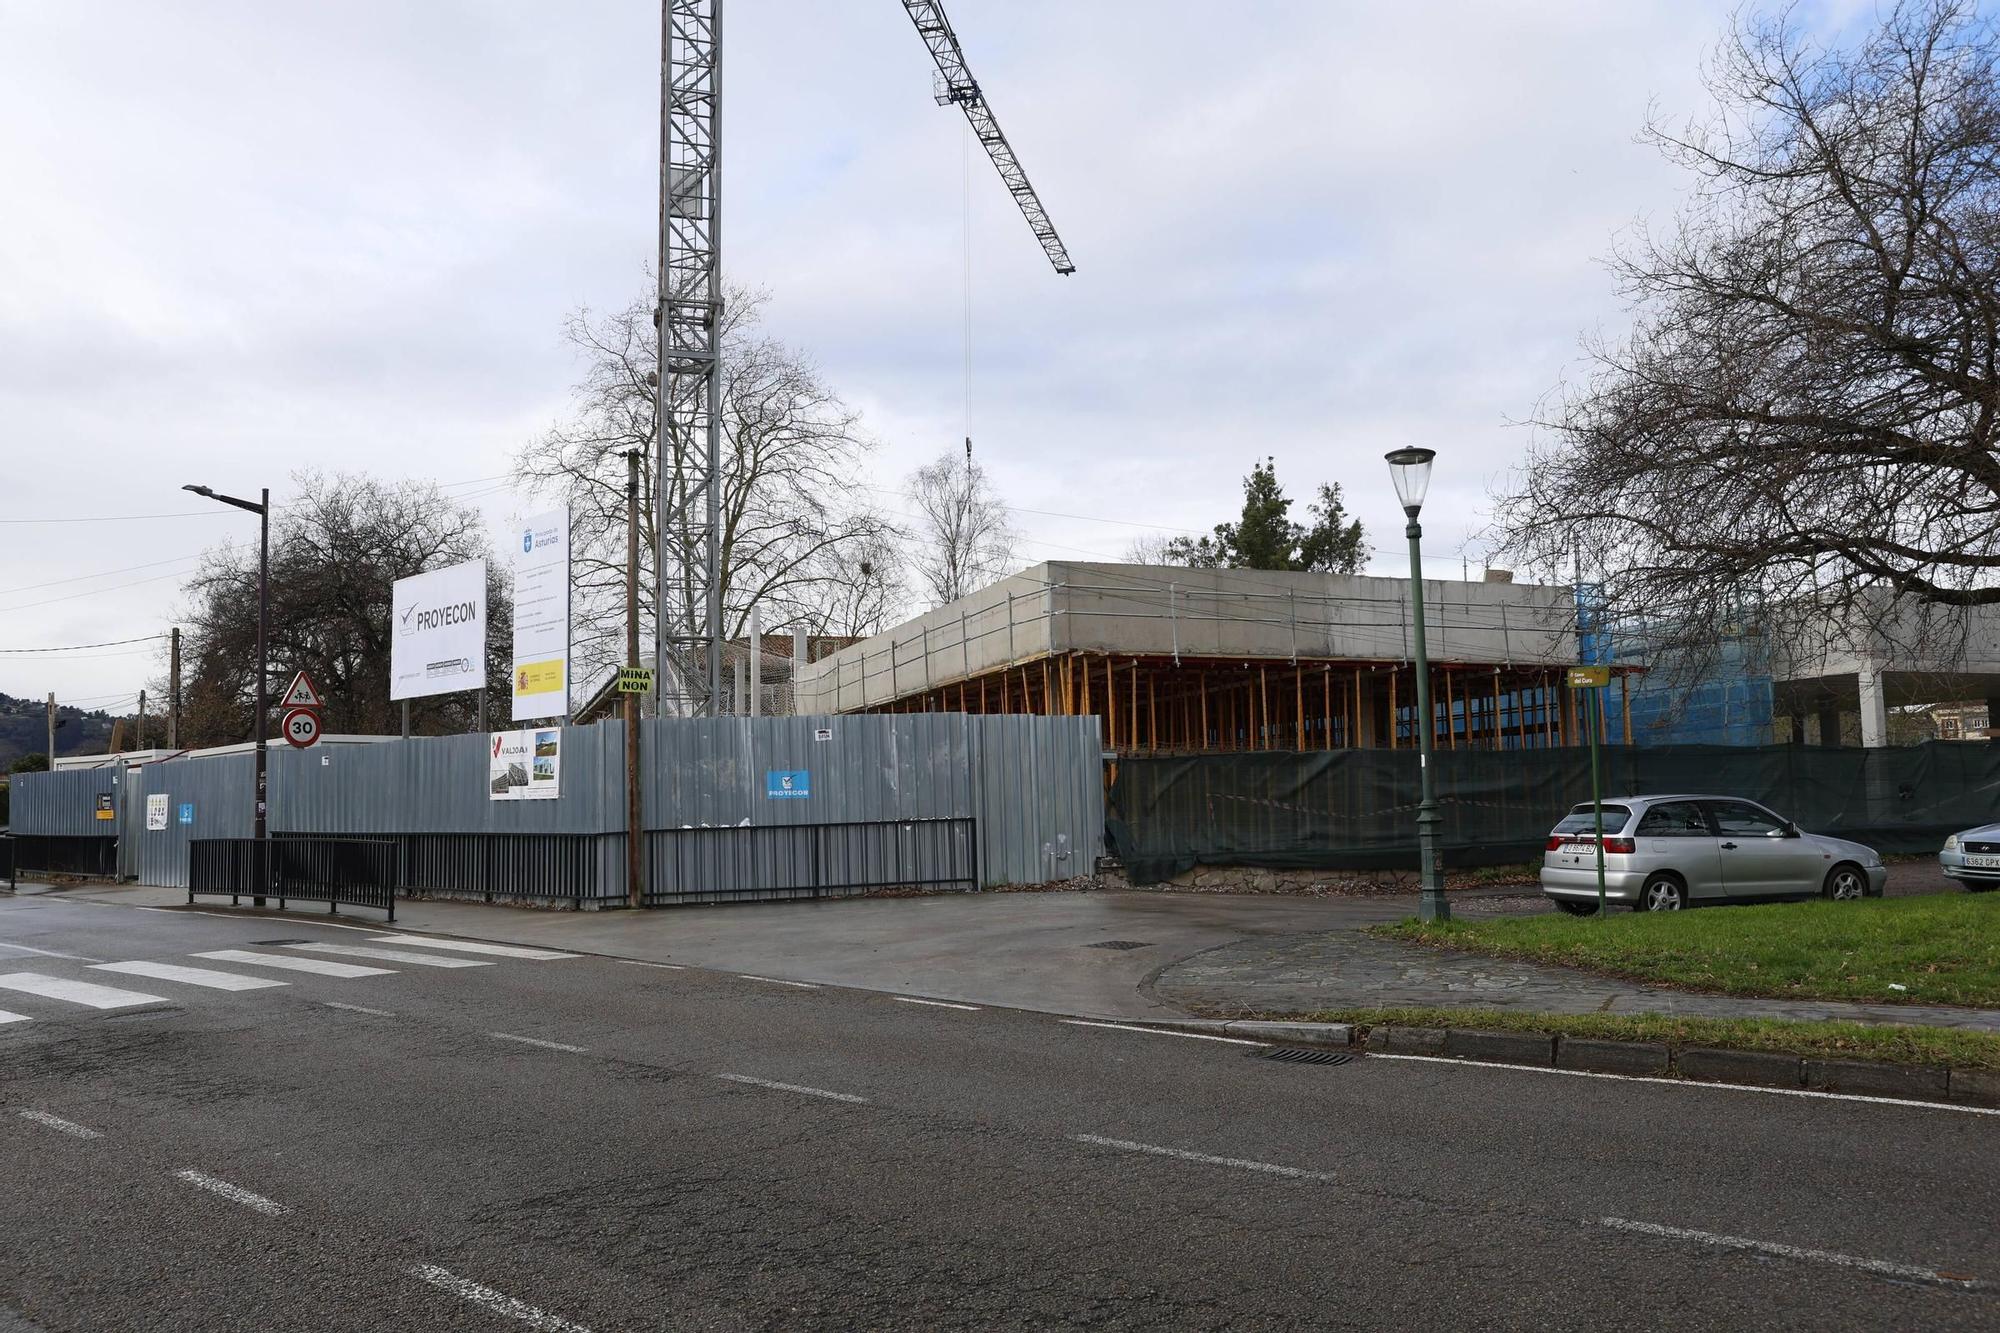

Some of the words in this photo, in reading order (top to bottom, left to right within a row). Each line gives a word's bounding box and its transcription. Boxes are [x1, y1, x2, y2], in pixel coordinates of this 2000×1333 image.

[534, 535, 559, 548] Asturias
[417, 600, 476, 631] PROYECON
[622, 681, 648, 691] NON
[292, 721, 313, 735] 30
